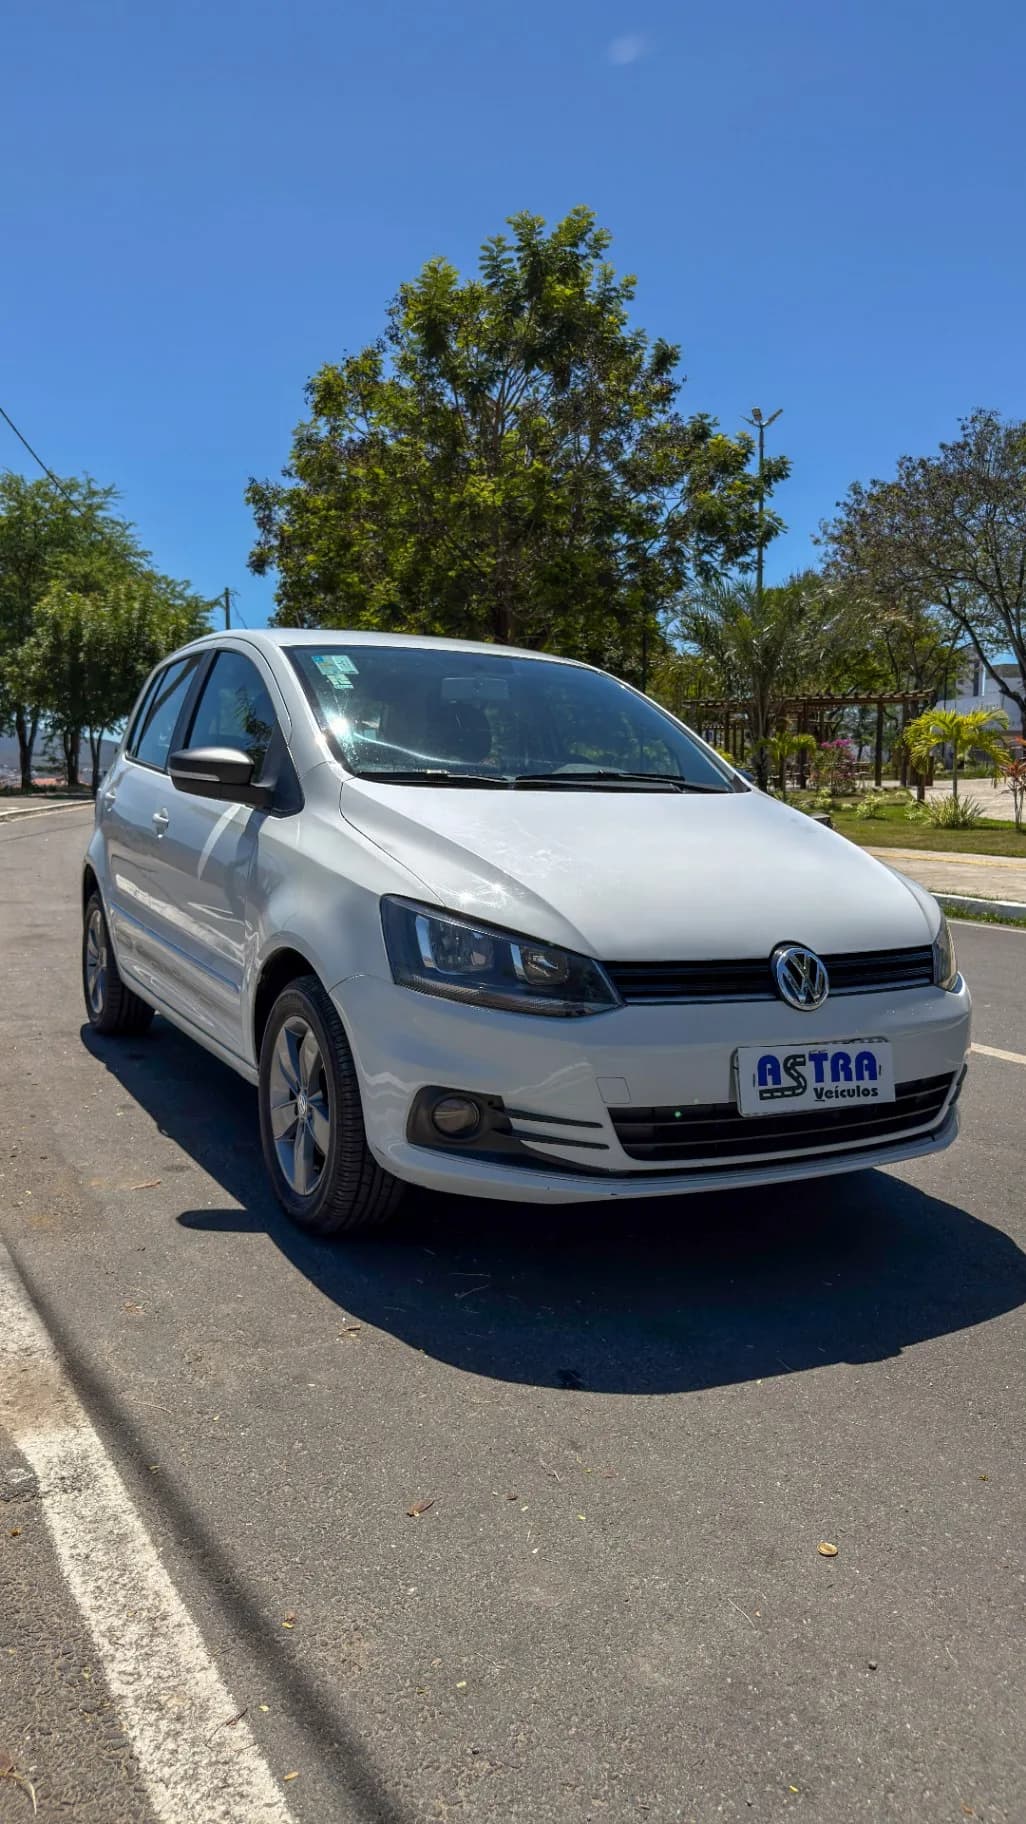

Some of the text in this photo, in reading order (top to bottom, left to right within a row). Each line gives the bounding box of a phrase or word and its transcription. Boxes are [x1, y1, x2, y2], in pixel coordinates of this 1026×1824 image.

[778, 948, 829, 1009] VW
[757, 1051, 878, 1100] ASTRA
[813, 1086, 879, 1102] Veículos
